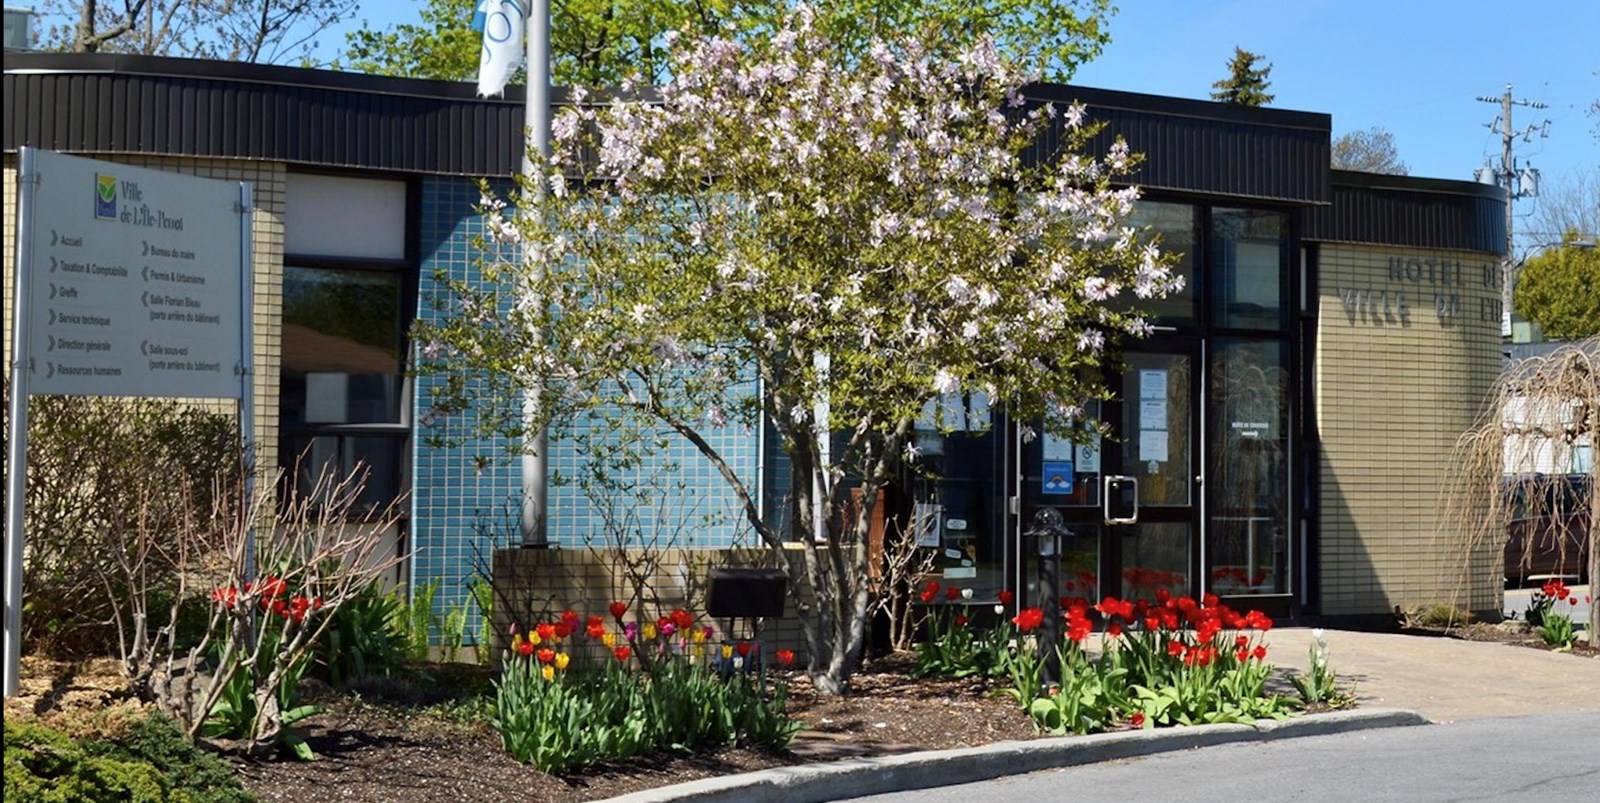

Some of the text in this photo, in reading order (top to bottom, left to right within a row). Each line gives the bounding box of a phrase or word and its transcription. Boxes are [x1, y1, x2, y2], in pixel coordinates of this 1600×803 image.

[121, 181, 143, 202] Ville
[120, 205, 132, 223] de
[60, 235, 83, 247] Accueil
[150, 245, 195, 260] Bureau du maire
[60, 260, 85, 273] Taxation
[85, 263, 91, 274] &
[150, 269, 205, 285] Permis & Urbanisme
[59, 286, 79, 298] Greffe
[150, 294, 164, 305] Salle
[1337, 287, 1410, 322] VILLE
[1434, 293, 1462, 320] DE
[58, 312, 111, 328] Service technique
[186, 312, 194, 322] du
[57, 338, 111, 353] Direction générale
[149, 344, 163, 355] Salle
[57, 364, 122, 376] Ressources humaines
[186, 361, 194, 371] du
